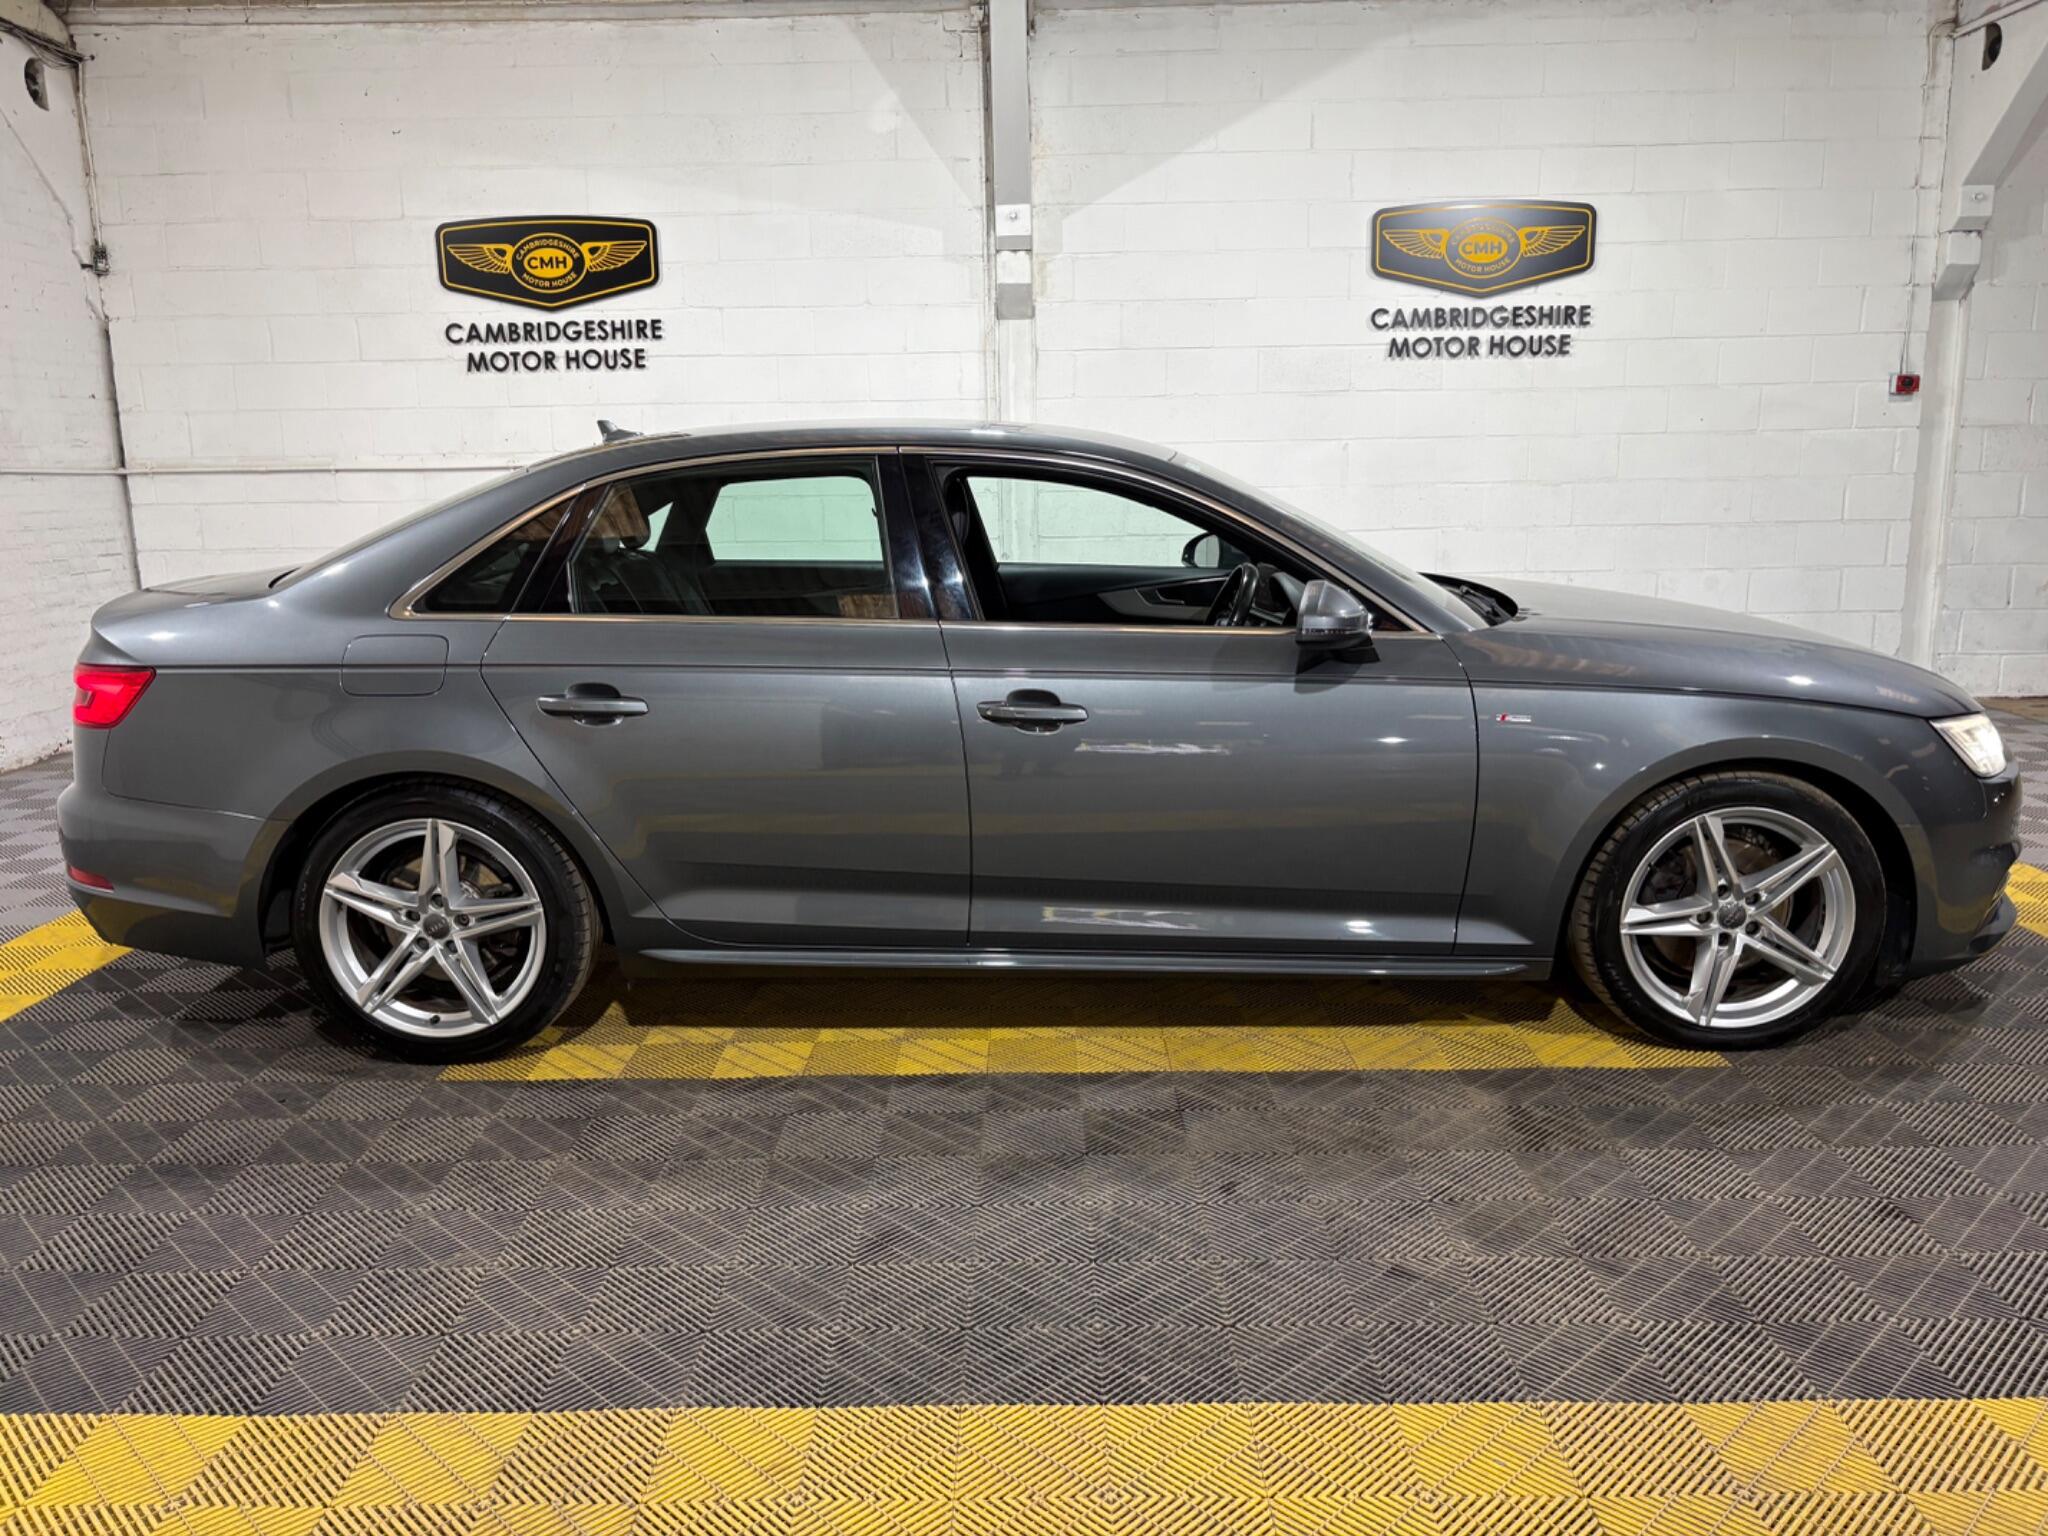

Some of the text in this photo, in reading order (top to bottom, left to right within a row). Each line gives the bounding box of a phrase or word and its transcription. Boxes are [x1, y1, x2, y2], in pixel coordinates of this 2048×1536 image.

[516, 239, 579, 260] CAMBRIDGESHIRE
[1461, 240, 1503, 255] CMH
[527, 256, 567, 269] CMH
[1456, 258, 1482, 273] MOTOR
[522, 271, 577, 288] MOTOR HOUSE
[1371, 305, 1592, 330] CAMBRIDGESHIRE
[446, 319, 663, 345] CAMBRIDGESHIRE
[1389, 335, 1571, 358] MOTOR HOUSE
[468, 348, 646, 373] MOTOR HOUSE
